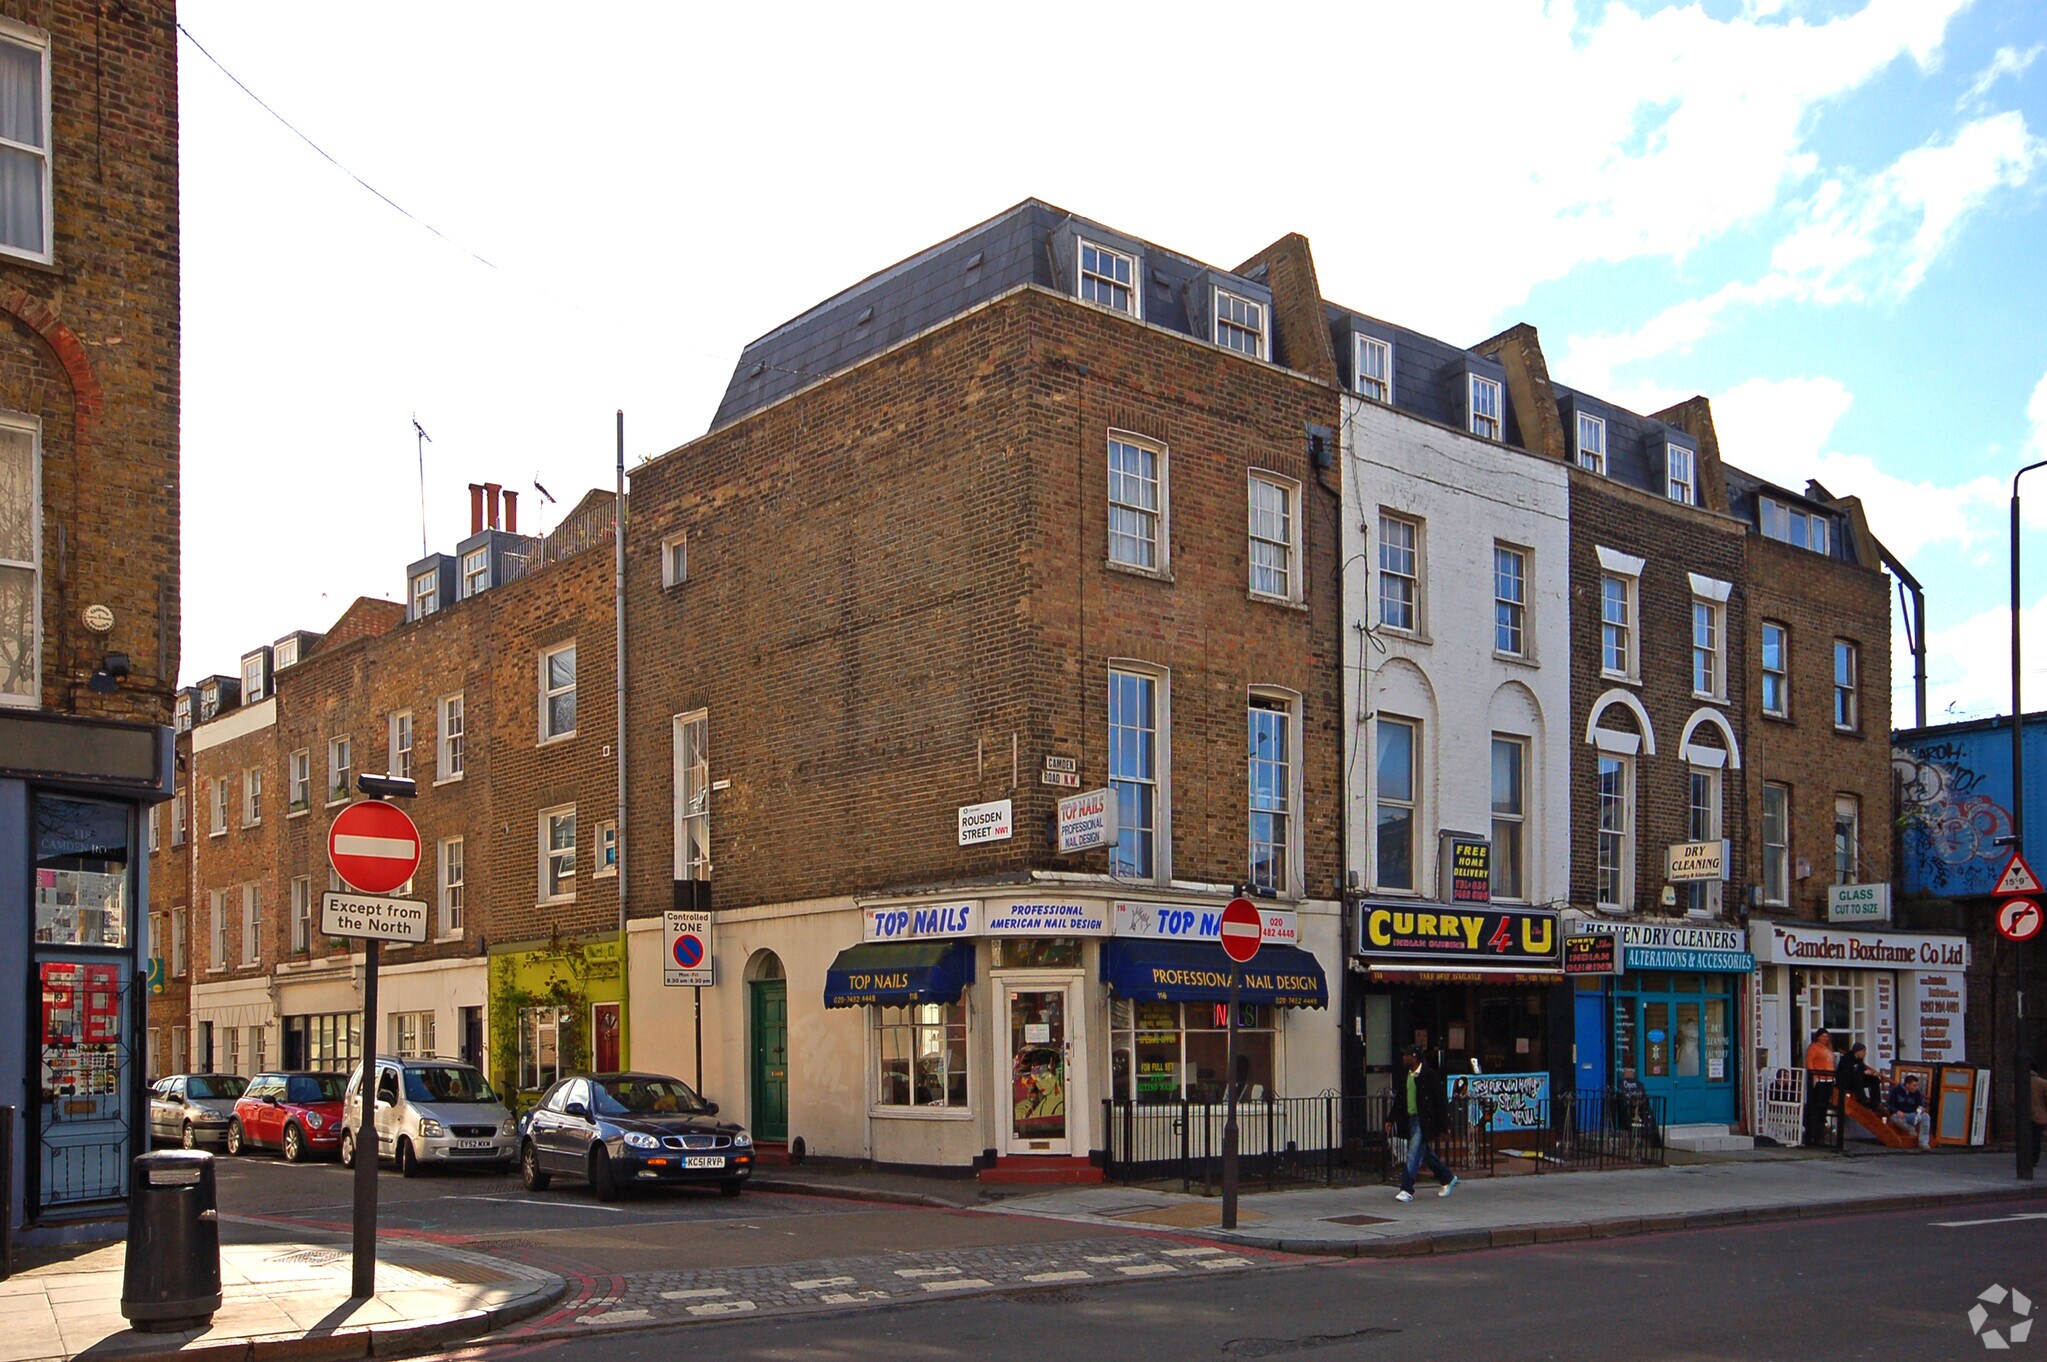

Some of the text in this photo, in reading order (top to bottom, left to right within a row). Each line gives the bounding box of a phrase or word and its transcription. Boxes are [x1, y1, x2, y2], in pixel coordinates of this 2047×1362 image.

[1048, 758, 1074, 770] CAMDEN
[1061, 795, 1104, 821] TOP NAILS
[962, 811, 1002, 828] ROUSDEN
[1061, 817, 1104, 836] PROFESSIONAL
[962, 826, 1009, 841] STREET NW1
[1064, 831, 1100, 848] NAIL DESIGN
[1456, 845, 1487, 857] FREE
[1684, 846, 1706, 857] DRY
[1458, 857, 1484, 867] HOME
[1671, 858, 1720, 871] CLEANING
[1453, 868, 1489, 879] DELIVERY
[1838, 889, 1874, 901] GLASS
[329, 899, 421, 919] Except from
[1011, 905, 1083, 916] PROFESSIONAL
[1835, 903, 1878, 915] CUT TO SIZE
[667, 912, 709, 921] Controlled
[875, 911, 909, 937] TOP
[913, 906, 970, 934] NAILS
[1157, 909, 1195, 935] TOP
[1269, 918, 1283, 926] 020
[338, 916, 412, 934] the North
[673, 922, 703, 932] ZONE
[990, 919, 1102, 930] AMERICAN NAIL DESIGN
[1277, 929, 1295, 938] 4448
[1487, 915, 1513, 953] 4
[1521, 917, 1552, 953] U
[1643, 927, 1672, 946] DRY
[1672, 929, 1738, 949] CLEANERS
[1393, 939, 1427, 948] INDIAN
[1566, 938, 1595, 946] CURRY
[1784, 934, 1963, 965] Camden Boxframe Co Ltd
[1569, 952, 1610, 962] INDIAN
[1628, 951, 1687, 967] ALTERATIONS
[1697, 953, 1752, 970] ACCESSORIES
[849, 973, 909, 990] TOP NAILS
[1152, 968, 1318, 991] PROFESSIONA NAIL DESIGN
[1141, 1062, 1174, 1072] FOR FULL SET
